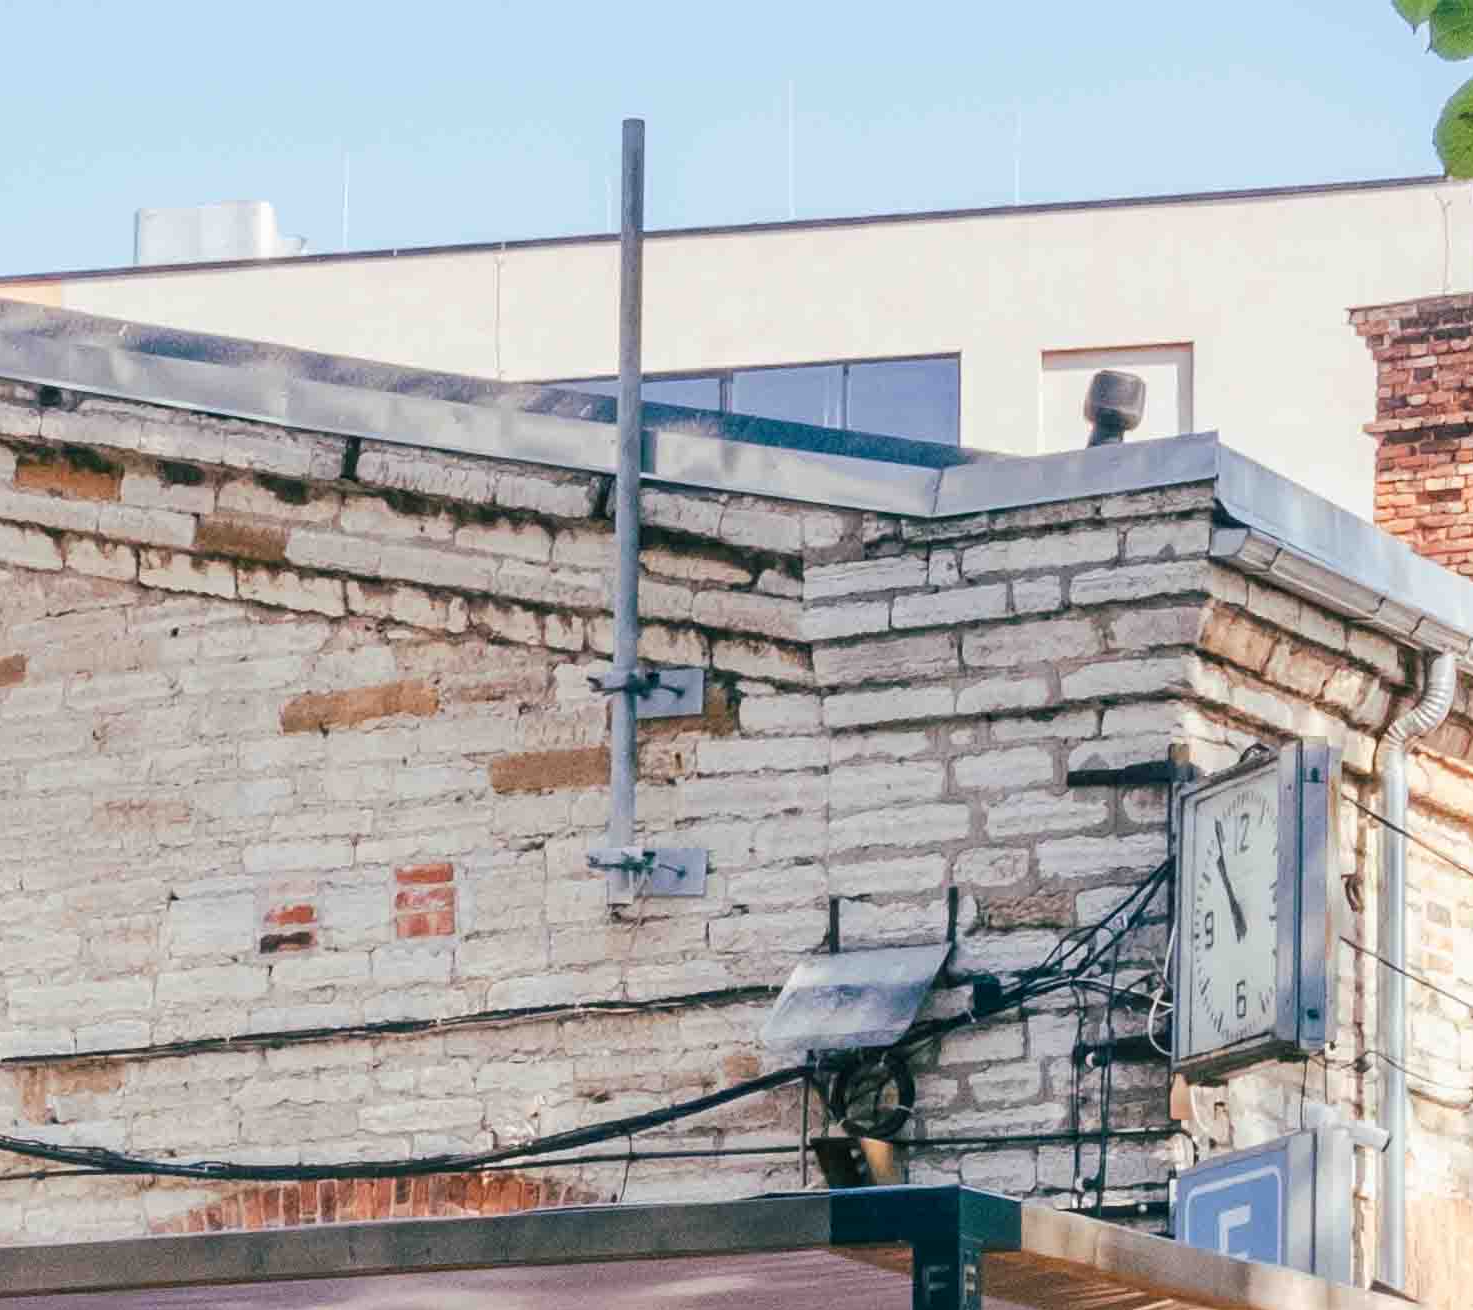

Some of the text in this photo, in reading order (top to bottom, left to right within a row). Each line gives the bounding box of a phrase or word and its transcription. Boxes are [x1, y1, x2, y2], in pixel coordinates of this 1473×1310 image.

[1233, 812, 1250, 854] 12
[1203, 911, 1214, 950] 9
[1235, 979, 1247, 1020] 6
